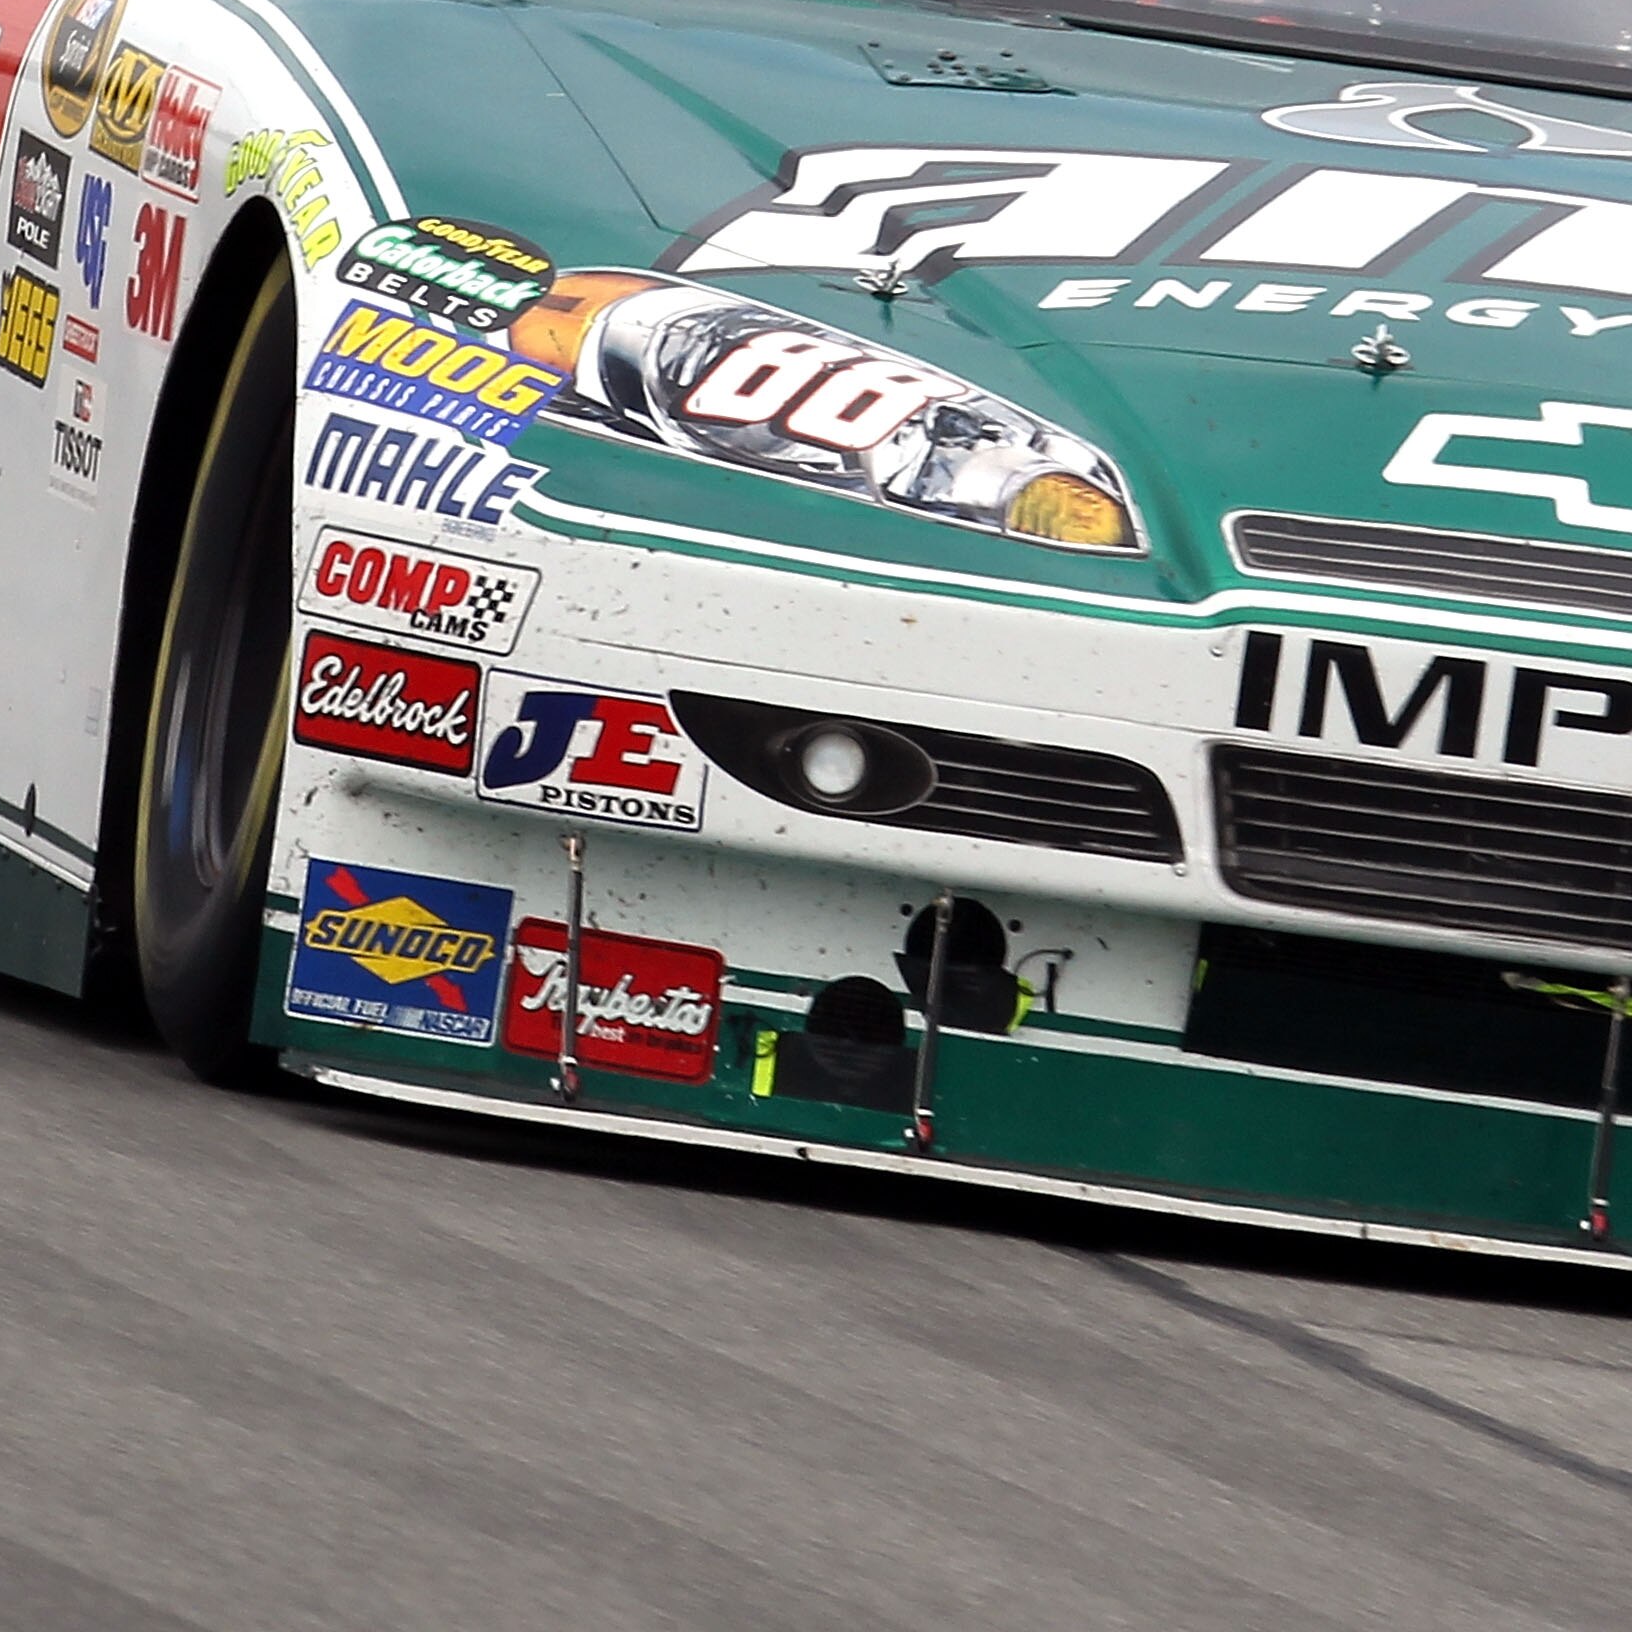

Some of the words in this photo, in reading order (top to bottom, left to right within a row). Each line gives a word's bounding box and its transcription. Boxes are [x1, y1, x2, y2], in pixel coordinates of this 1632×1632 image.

[15, 215, 50, 250] POLE
[355, 223, 546, 312] Gatorback
[417, 218, 551, 275] GOODYEAR
[126, 201, 188, 342] 3M
[344, 261, 499, 329] BELTS
[323, 304, 564, 416] MOOG
[680, 328, 970, 453] 88
[313, 361, 412, 408] CHASSIS
[421, 393, 514, 437] PARTS
[53, 418, 103, 484] TISSOT
[304, 412, 541, 526] MAHLE
[314, 538, 470, 616] COMP
[409, 608, 489, 643] CAMS
[300, 655, 469, 745] Edelbrock
[482, 690, 681, 797] JE
[538, 783, 697, 826] PISTONS
[312, 914, 495, 968] SUNOCO
[590, 1023, 626, 1044] best
